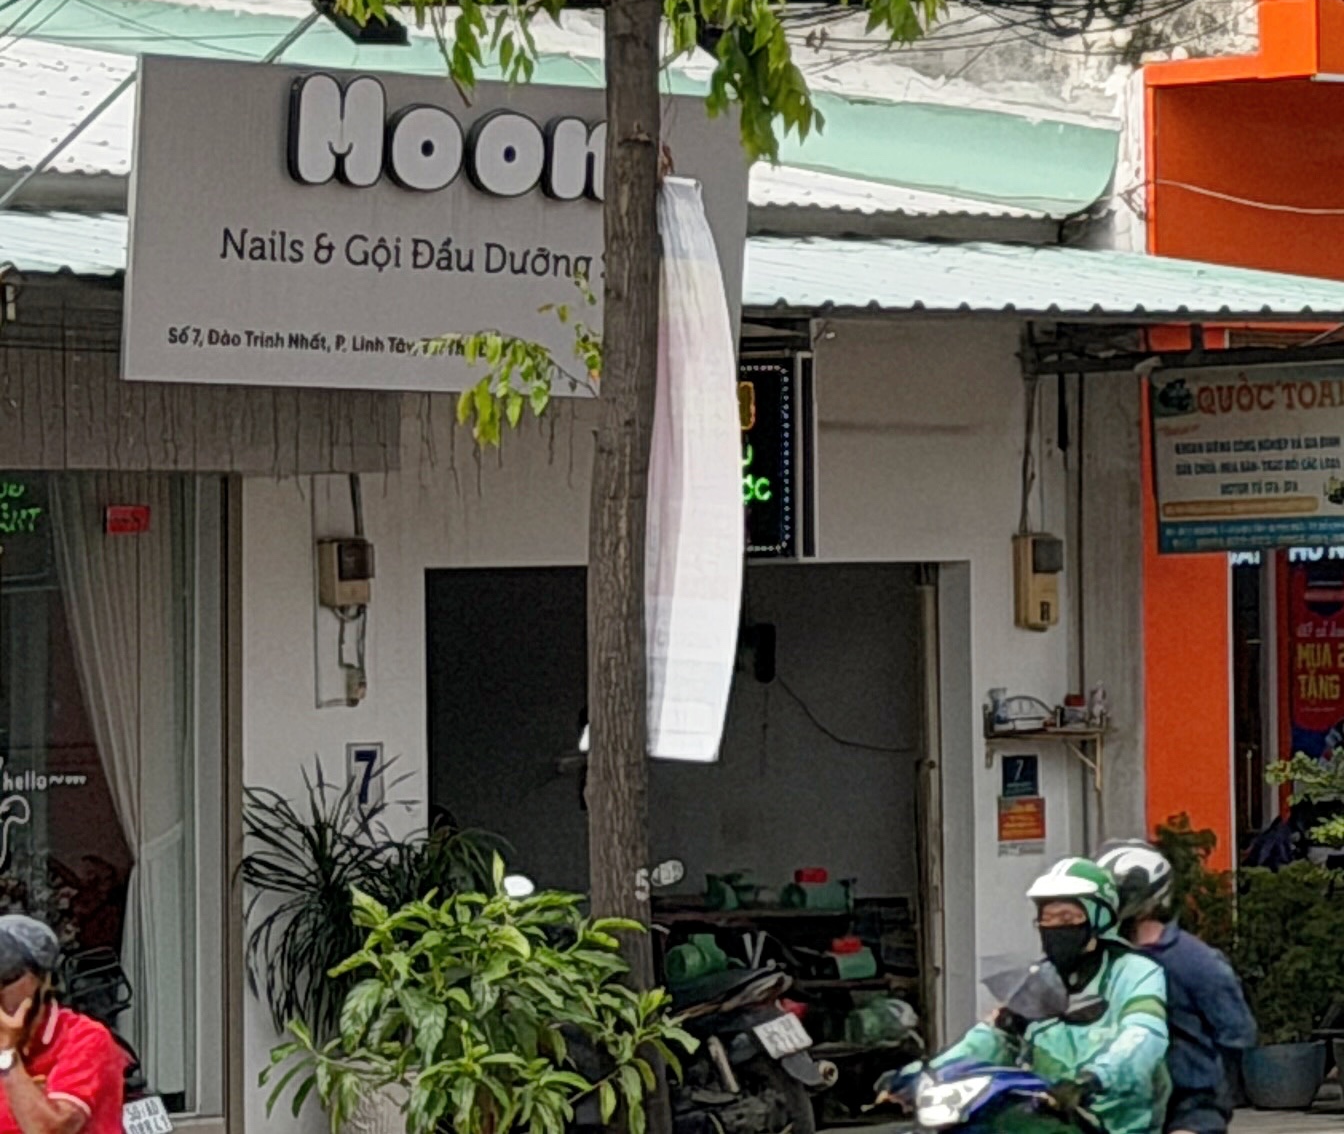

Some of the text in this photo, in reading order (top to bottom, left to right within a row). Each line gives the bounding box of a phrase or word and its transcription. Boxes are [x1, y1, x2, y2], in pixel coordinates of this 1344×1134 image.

[221, 226, 305, 265] Nails
[314, 232, 336, 265] &
[345, 234, 401, 273] Gội
[168, 325, 190, 344] Số
[1296, 642, 1332, 669] MUA
[2, 770, 47, 792] hello
[355, 749, 378, 805] 7
